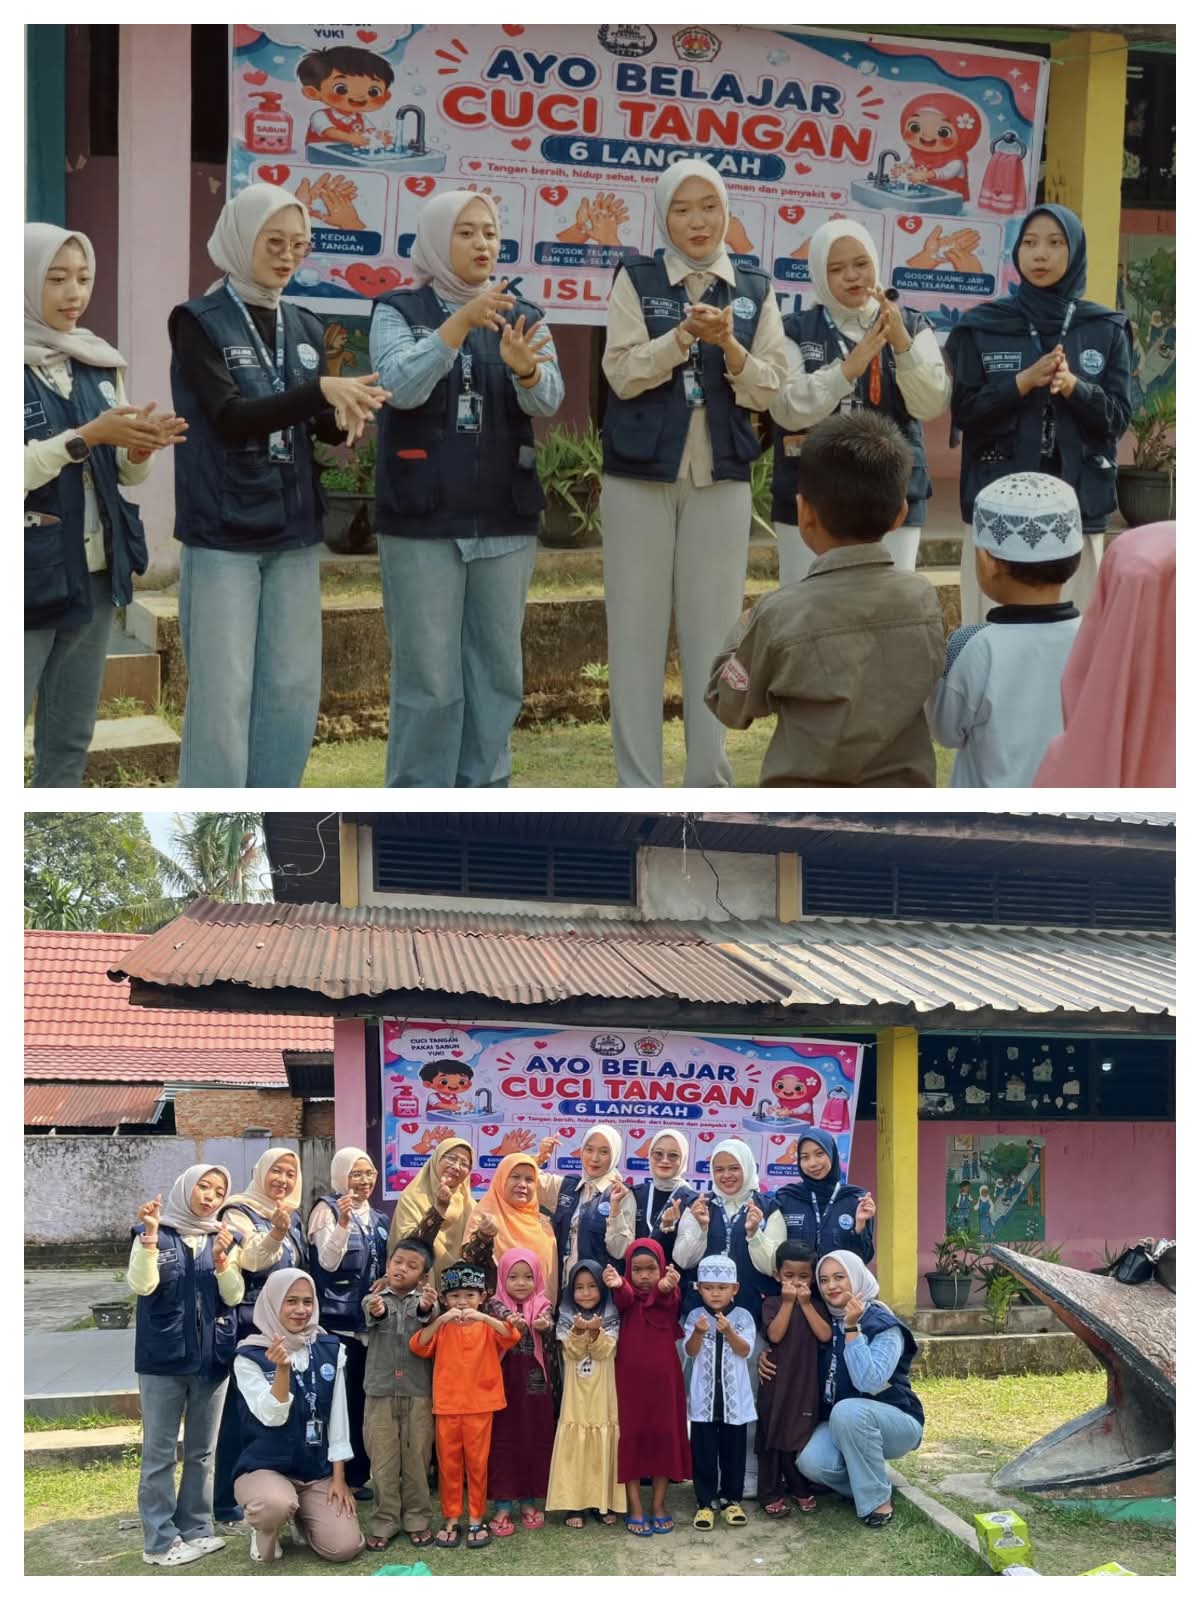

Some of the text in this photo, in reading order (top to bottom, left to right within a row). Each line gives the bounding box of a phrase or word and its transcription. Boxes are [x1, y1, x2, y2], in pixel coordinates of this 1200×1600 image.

[313, 28, 344, 39] YUK!
[485, 48, 841, 115] AYO BELAJAR
[255, 125, 287, 135] SABUN
[442, 86, 873, 162] CUCI TANGAN
[569, 141, 589, 161] 6
[269, 168, 278, 180] 1
[487, 163, 528, 176] Tangan
[531, 167, 569, 178] bersih,
[572, 169, 603, 181] hidup
[605, 172, 637, 183] sehat,
[415, 179, 427, 192] 2
[724, 183, 825, 200] uman dan penyakit
[550, 190, 559, 201] 3
[786, 208, 797, 219] 5
[905, 220, 916, 230] 6
[320, 232, 357, 243] KEDUA
[321, 242, 364, 253] TANGAN
[551, 246, 624, 258] GOSOK TELAPAK
[541, 255, 563, 264] DAN
[791, 263, 808, 271] GOS
[903, 271, 985, 285] GOSOK UJUNG JARI
[543, 278, 606, 301] ISL
[897, 279, 991, 294] PADA TELAPAK TANGAN
[525, 1055, 736, 1081] AYO BELAJAR
[501, 1076, 755, 1107] CUCI TANGAN
[574, 1102, 688, 1117] 6 LANGKAH
